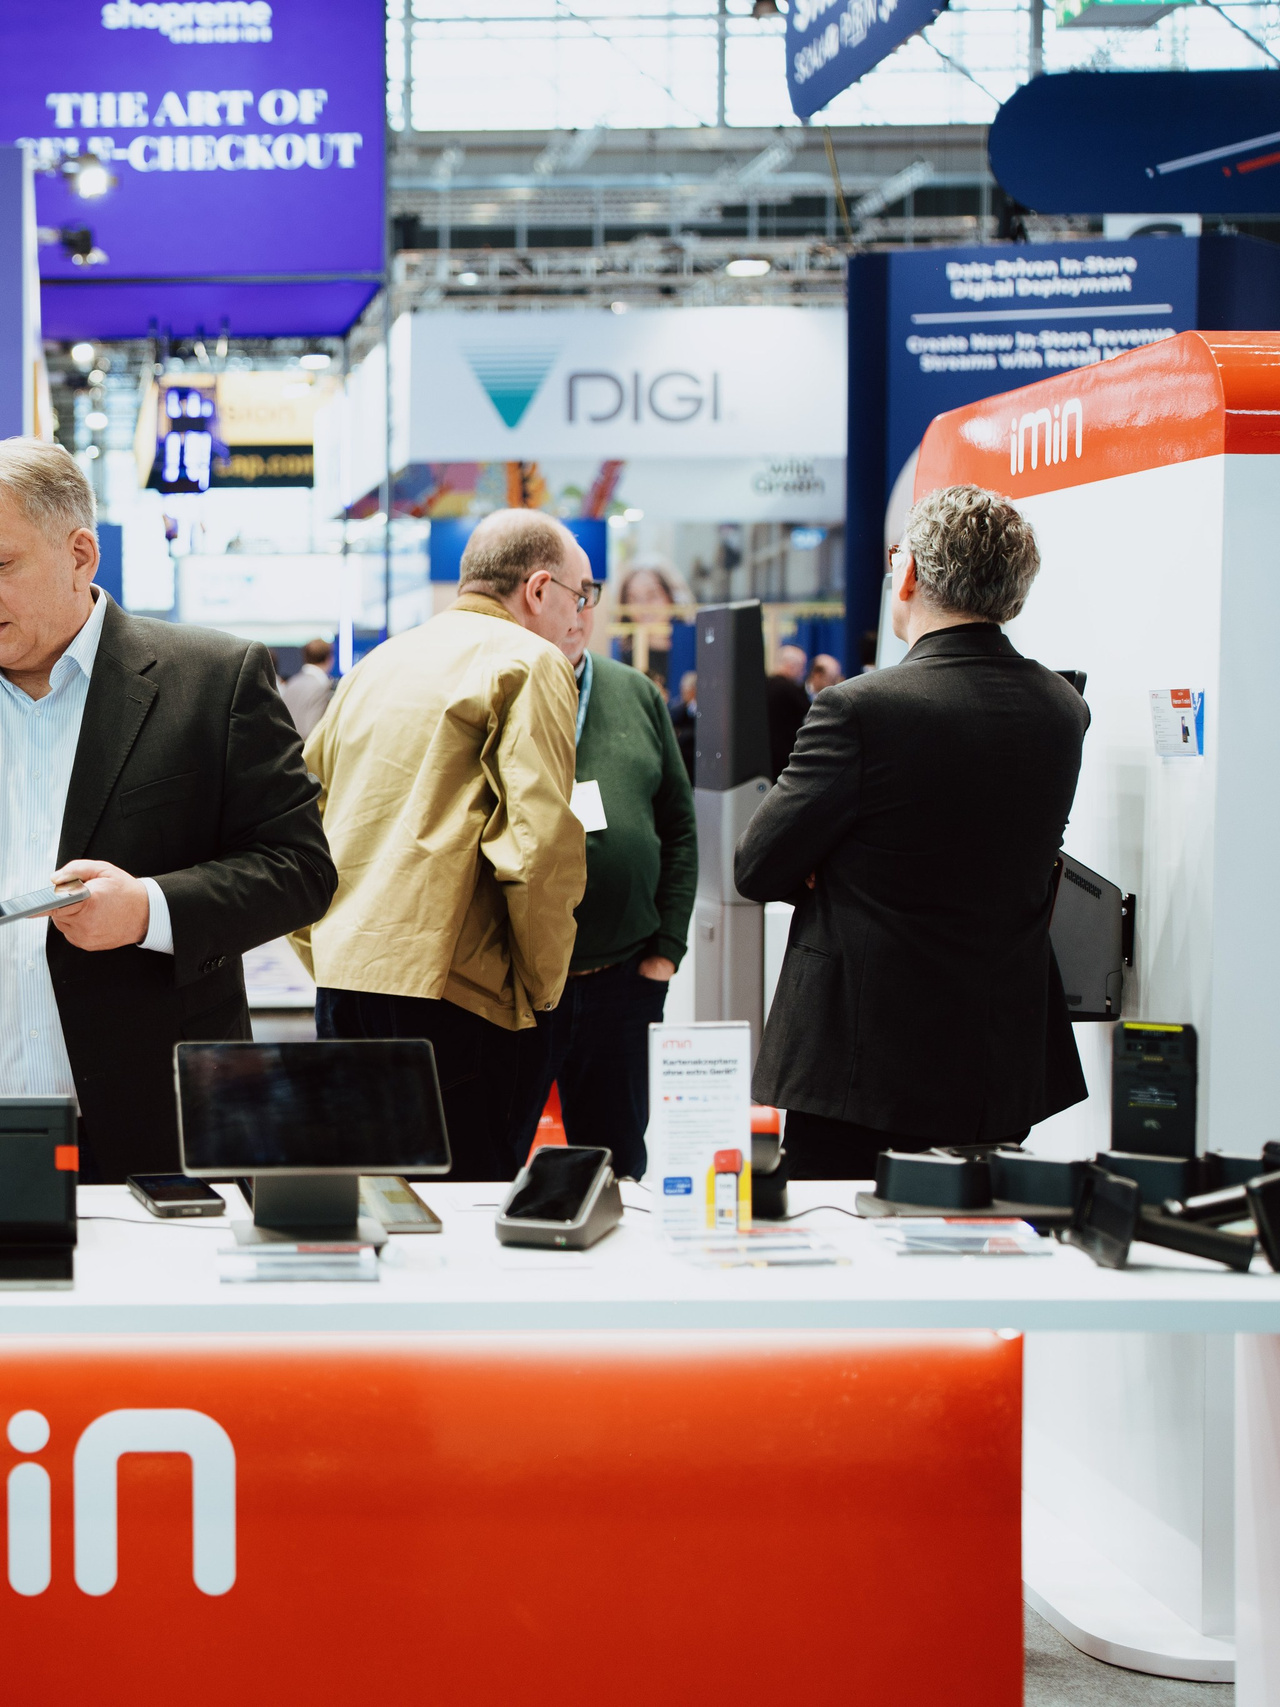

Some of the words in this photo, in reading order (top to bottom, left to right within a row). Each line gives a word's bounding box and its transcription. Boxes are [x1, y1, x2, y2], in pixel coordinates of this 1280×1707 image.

[45, 91, 150, 129] THE
[152, 90, 255, 128] ART
[257, 88, 329, 126] OF
[945, 257, 1059, 281] Data-Driven
[1060, 255, 1138, 276] In-Store
[949, 277, 1015, 302] Digital
[1016, 273, 1132, 298] Deployment
[906, 333, 969, 355] Create
[970, 332, 1014, 352] New
[1015, 330, 1092, 350] In-Store
[919, 353, 998, 373] Streams
[998, 349, 1044, 370] with
[567, 370, 719, 424] DIGI
[1010, 397, 1083, 476] imin
